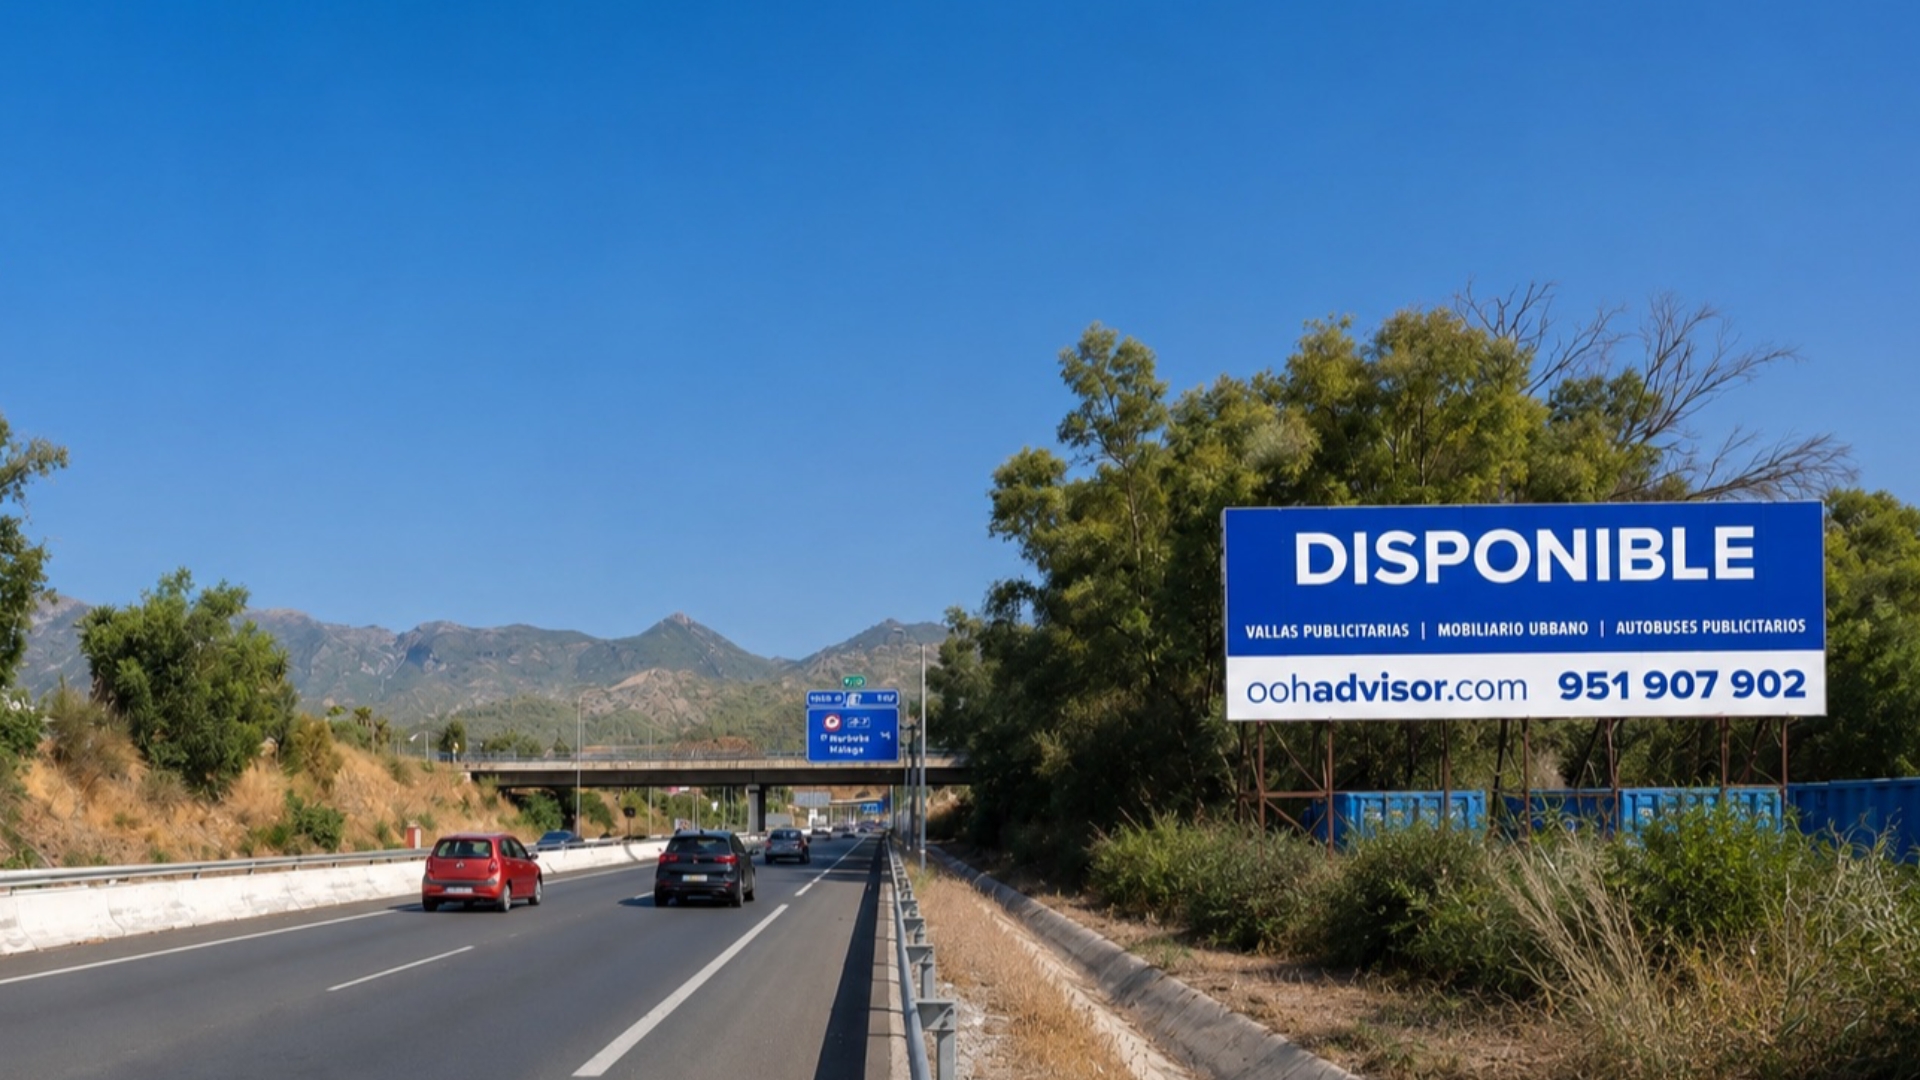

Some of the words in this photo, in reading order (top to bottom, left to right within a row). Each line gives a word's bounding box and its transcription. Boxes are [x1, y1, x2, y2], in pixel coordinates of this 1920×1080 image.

[1295, 527, 1755, 585] DISPONIBLE
[1245, 624, 1299, 639] VALLAS
[1303, 623, 1410, 638] PUBLICITARIAS
[1437, 622, 1524, 637] MOBILIARIO
[1616, 620, 1698, 635] AUTOBUSES
[1702, 618, 1806, 634] PUBLICITARIOS
[1246, 671, 1527, 704] oohadvisor.com
[1557, 670, 1629, 701] 951
[1642, 669, 1719, 700] 907
[1730, 668, 1807, 699] 902
